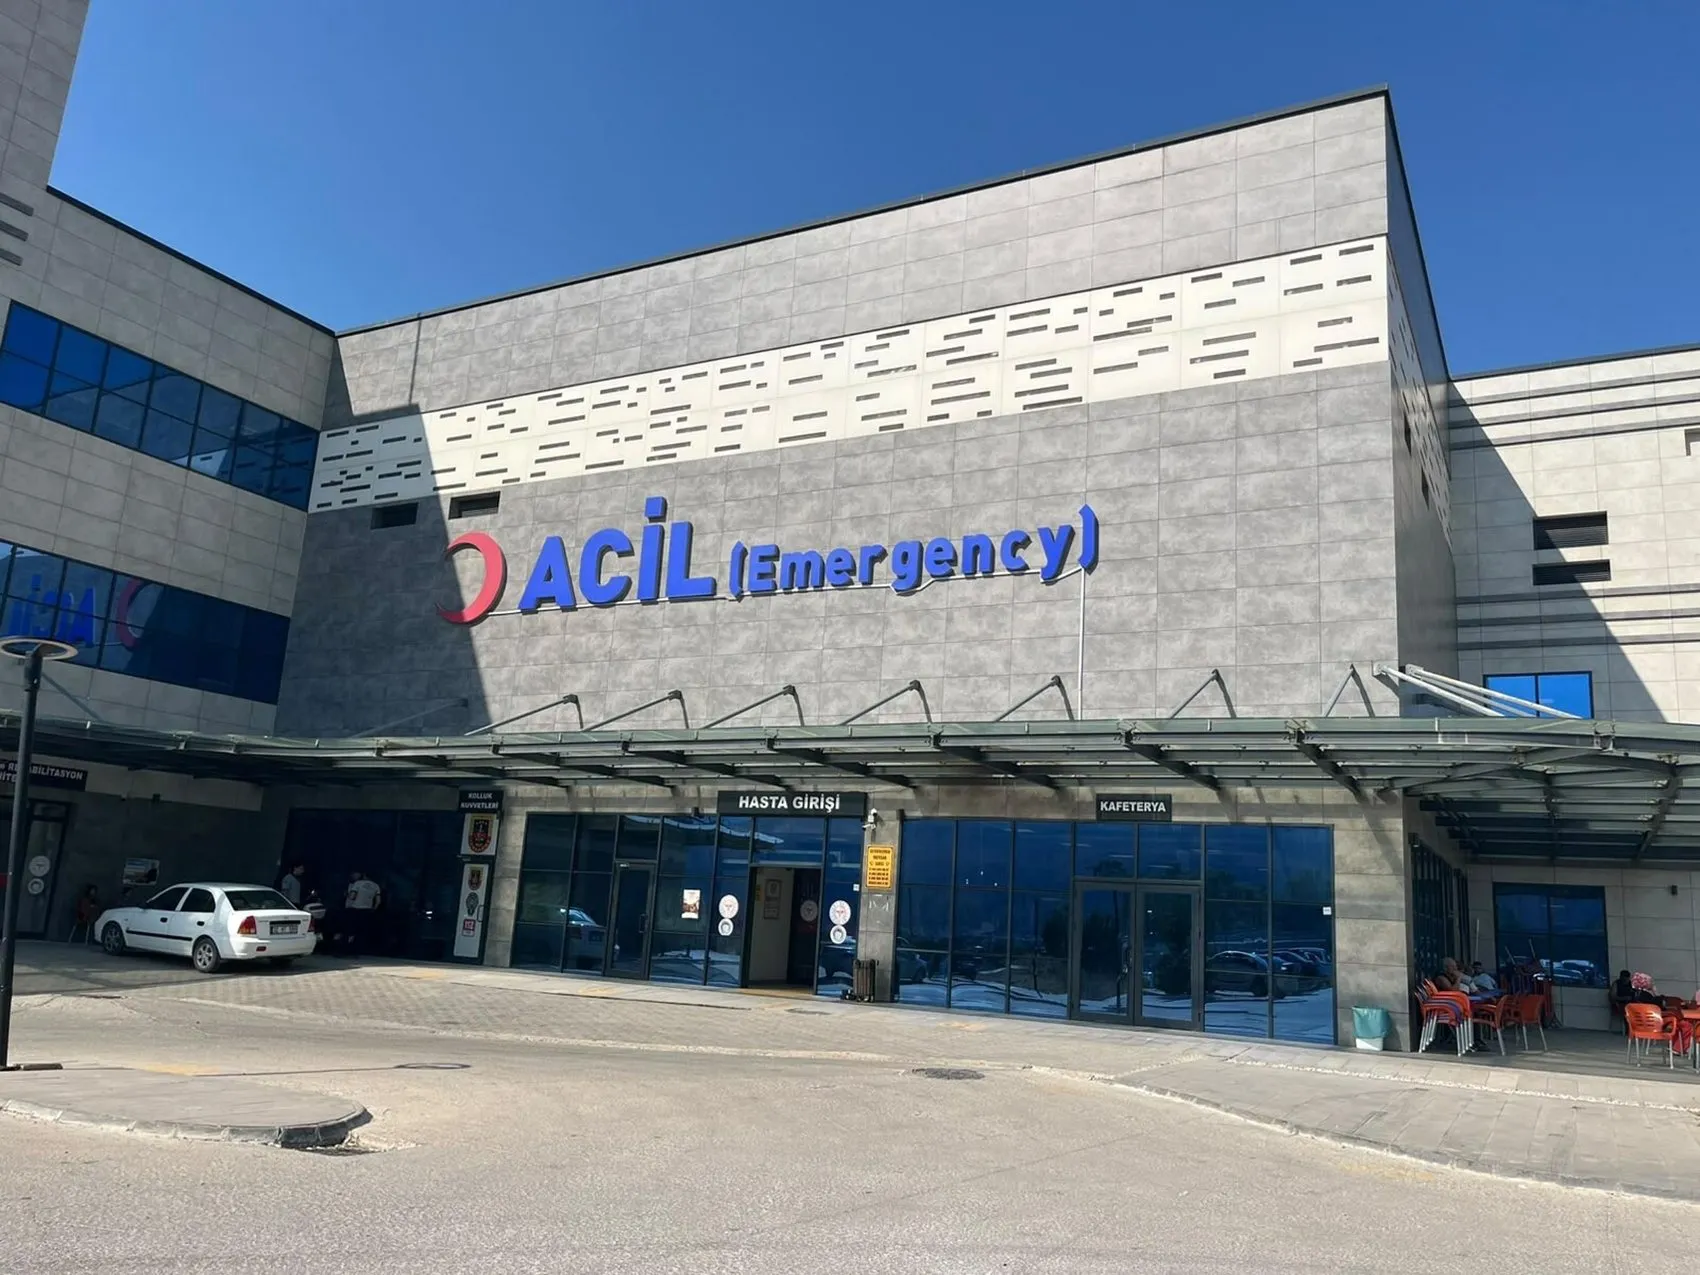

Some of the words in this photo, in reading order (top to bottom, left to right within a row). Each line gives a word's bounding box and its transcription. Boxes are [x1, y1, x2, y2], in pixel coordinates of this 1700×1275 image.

[520, 497, 716, 612] ACİL
[730, 504, 1099, 598] (Emergency)
[468, 792, 493, 800] KOLLUK
[739, 795, 788, 809] HASTA
[792, 793, 840, 813] GİRİŞİ
[1100, 801, 1166, 812] KAFETERYA
